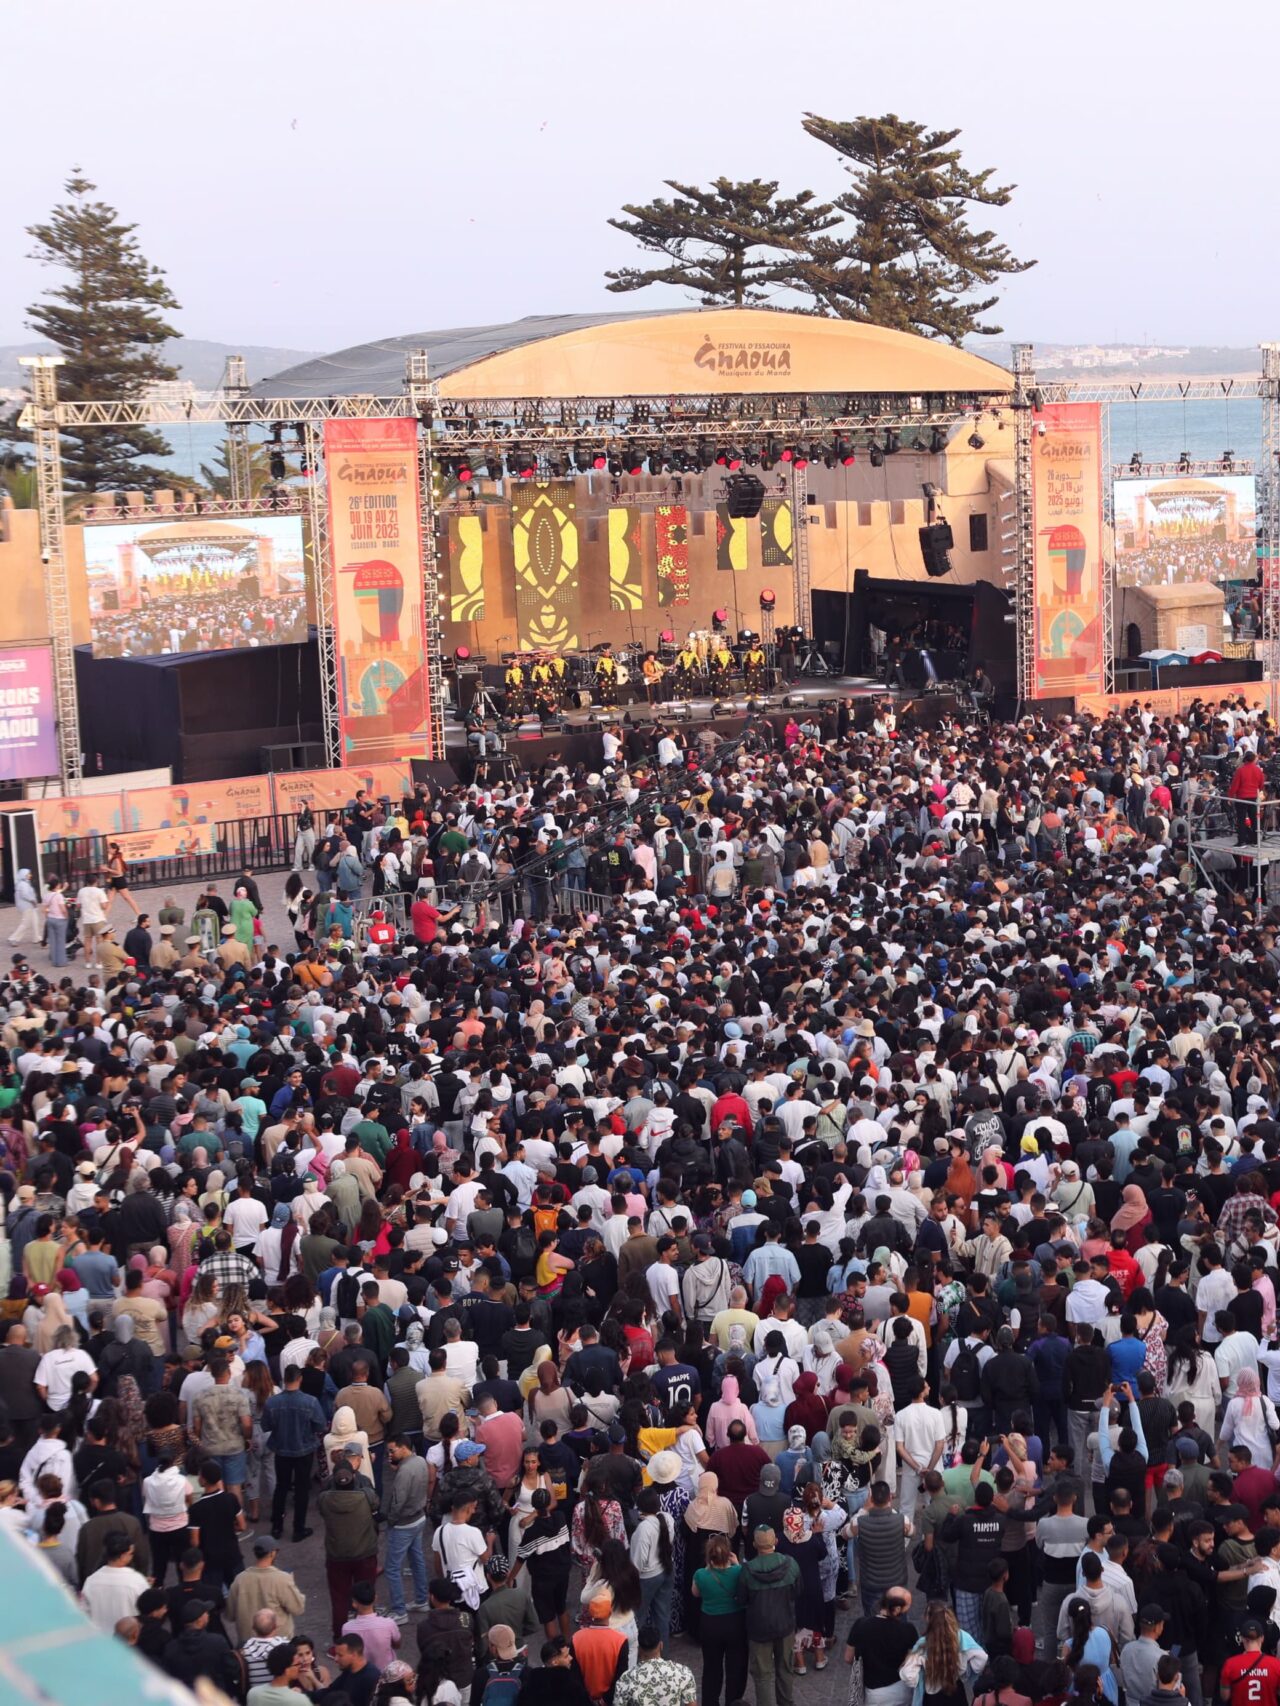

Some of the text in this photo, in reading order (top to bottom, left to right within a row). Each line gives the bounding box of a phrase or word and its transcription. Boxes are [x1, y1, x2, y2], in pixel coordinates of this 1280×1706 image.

[718, 370, 752, 378] Musiques
[1048, 495, 1063, 506] 2025
[350, 510, 398, 524] DU 19 AU 21
[351, 524, 399, 540] JUIN 2025
[668, 1384, 691, 1409] 10
[1248, 1680, 1261, 1701] 2
